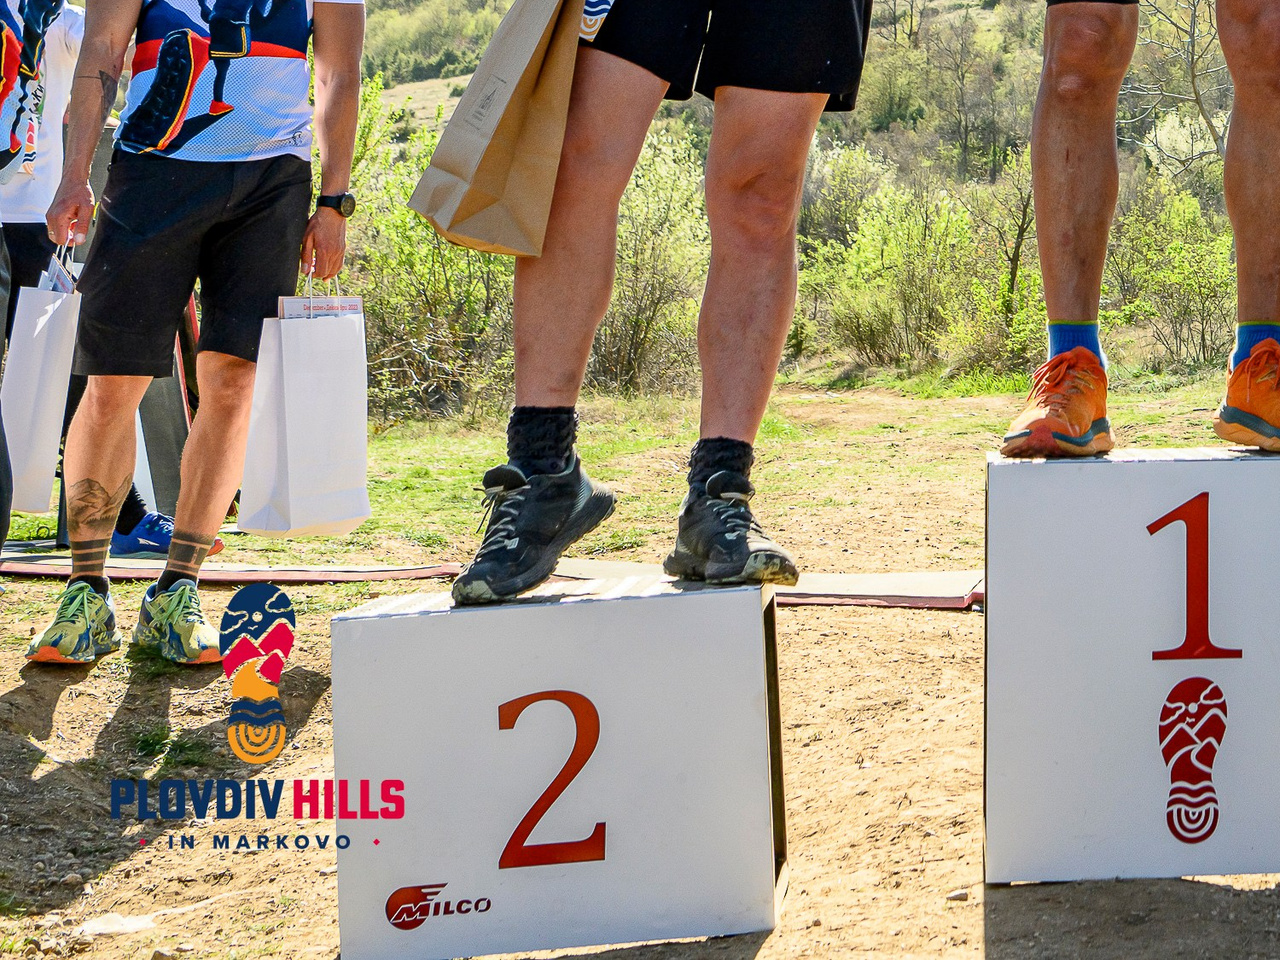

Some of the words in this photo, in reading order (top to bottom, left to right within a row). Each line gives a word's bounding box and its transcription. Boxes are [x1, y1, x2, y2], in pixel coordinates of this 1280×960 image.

[1146, 491, 1243, 661] 1
[498, 690, 606, 869] 2
[390, 898, 492, 923] MILCO
